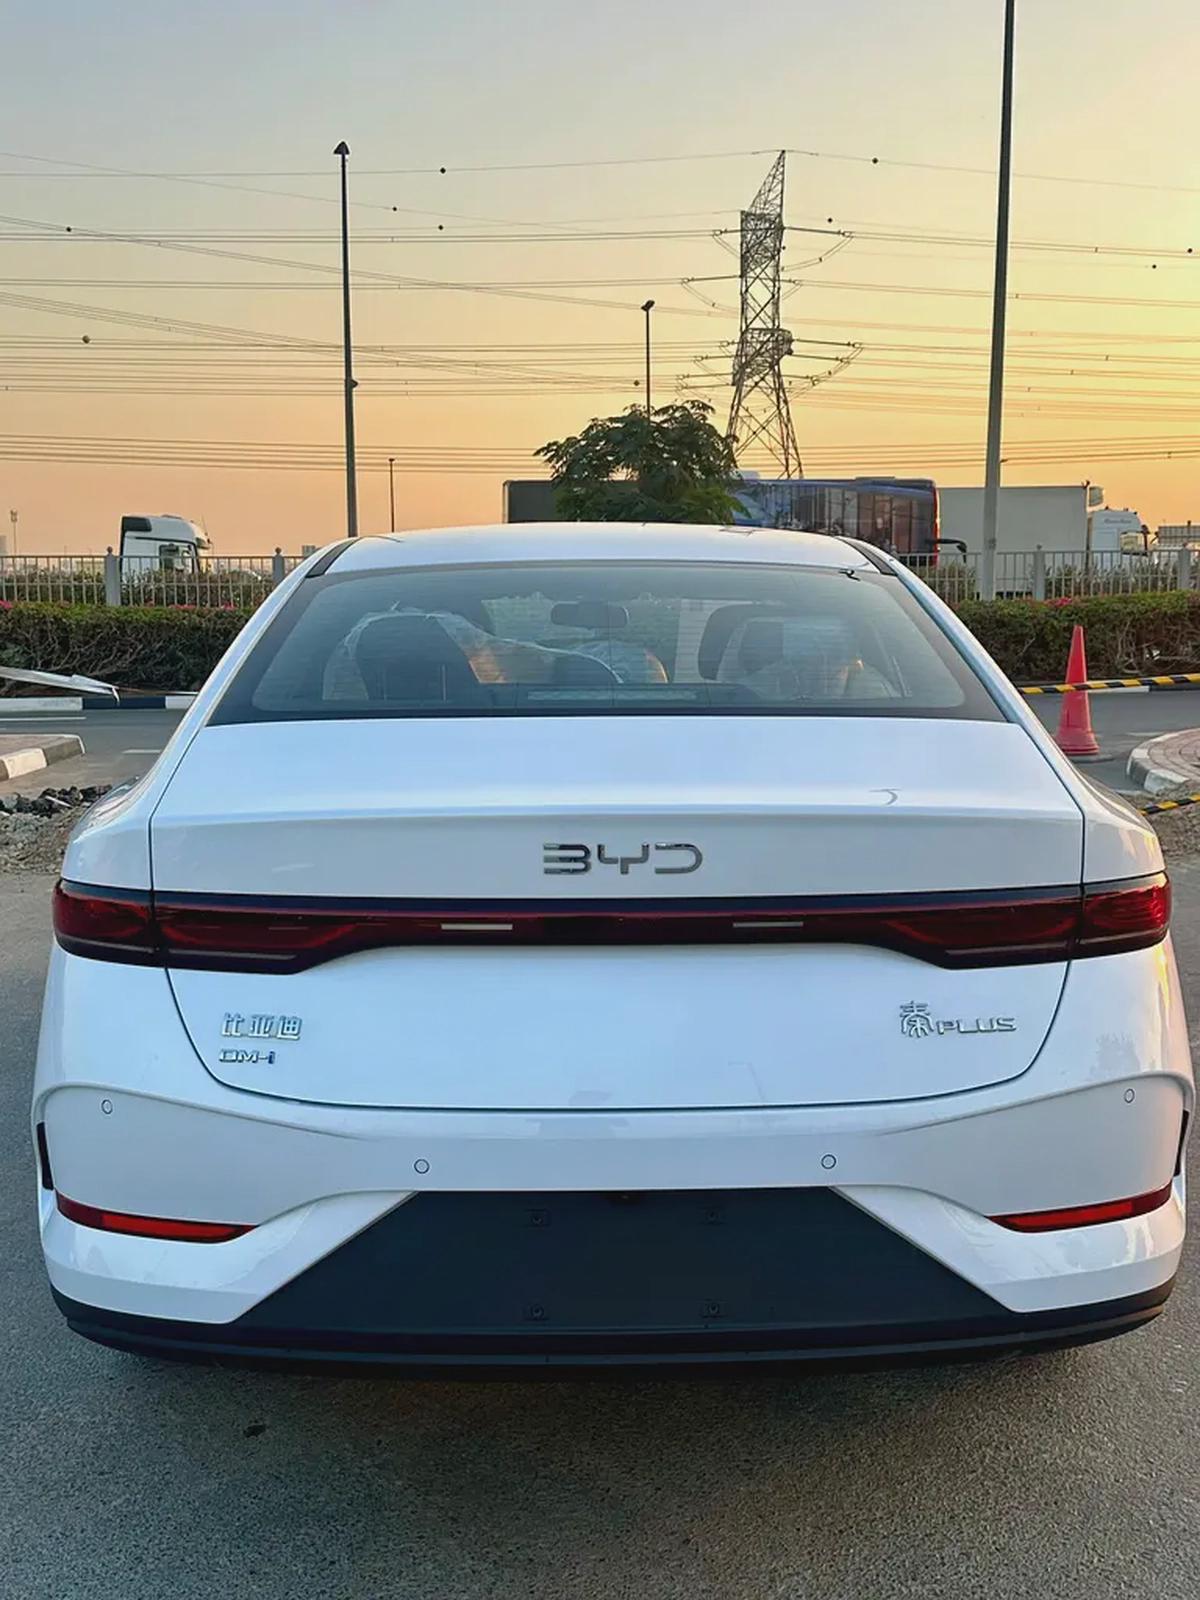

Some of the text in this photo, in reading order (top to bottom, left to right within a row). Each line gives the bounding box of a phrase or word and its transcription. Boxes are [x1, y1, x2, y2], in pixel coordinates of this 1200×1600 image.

[543, 843, 703, 875] BYD
[221, 1012, 302, 1040] 比亚迪
[936, 1017, 1016, 1035] PLUS
[219, 1049, 276, 1064] DM-i
